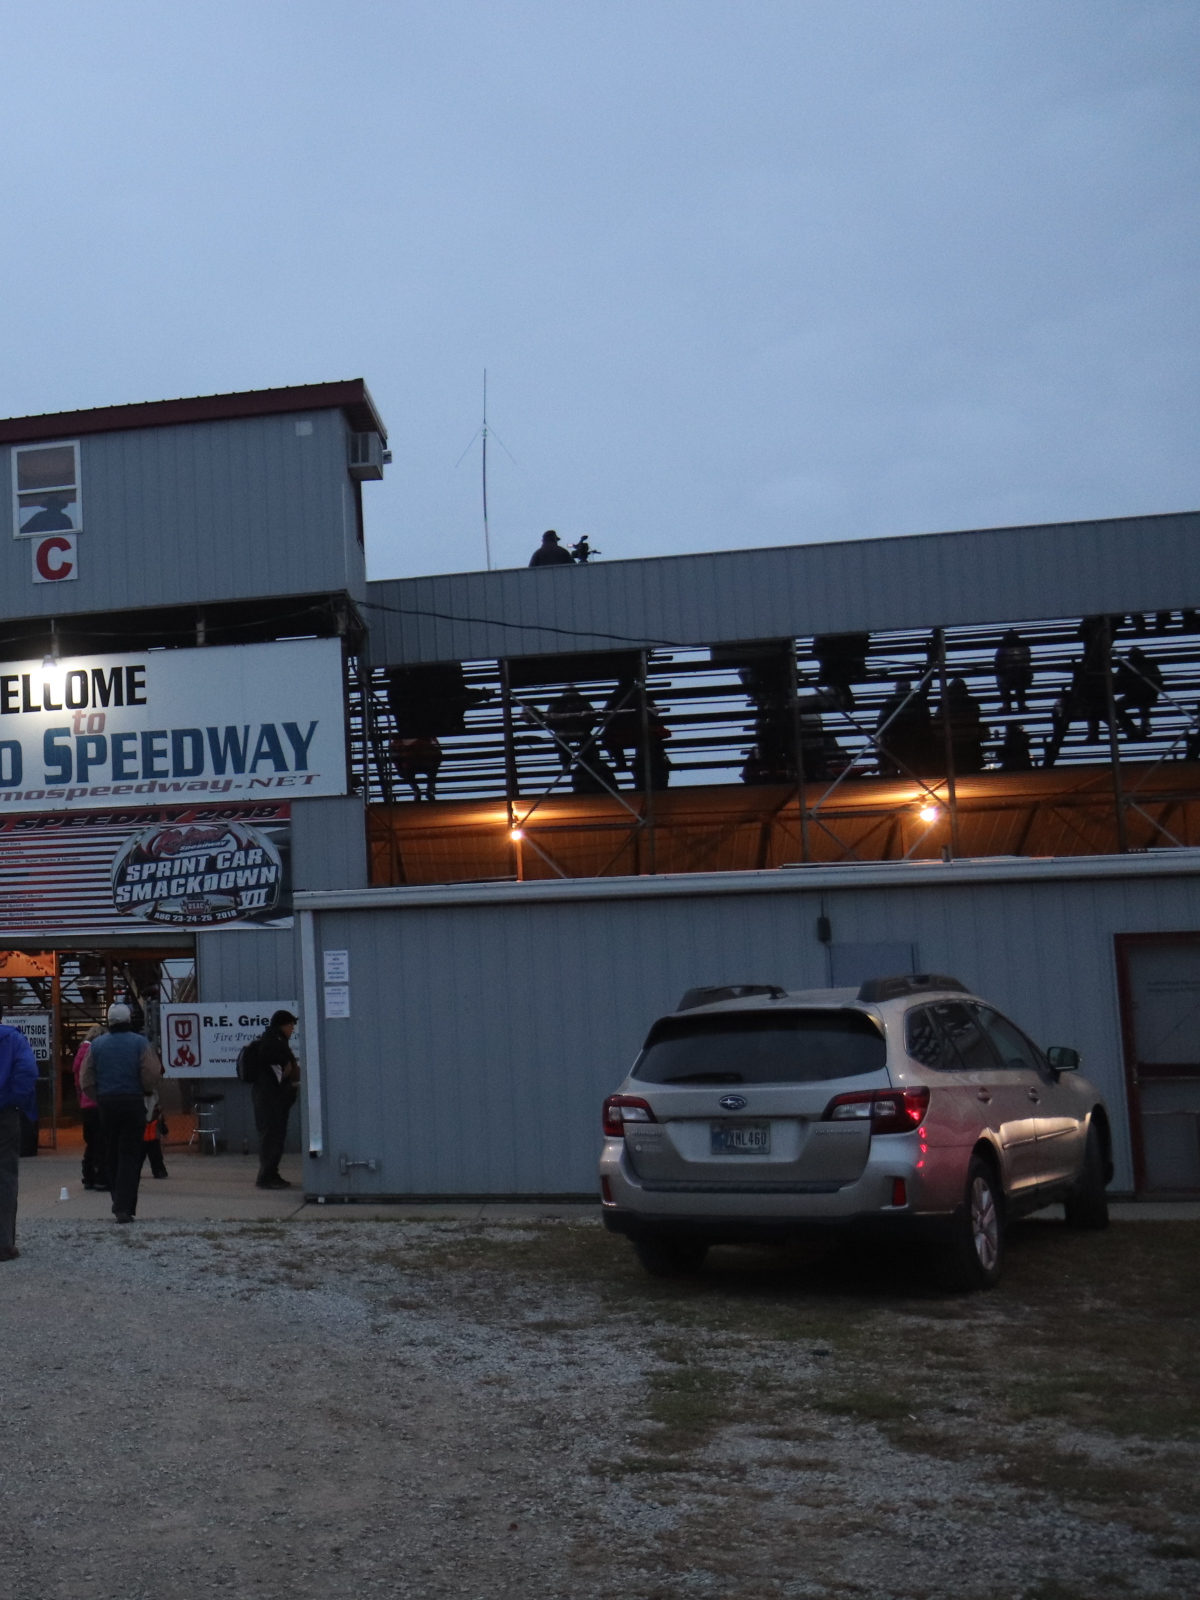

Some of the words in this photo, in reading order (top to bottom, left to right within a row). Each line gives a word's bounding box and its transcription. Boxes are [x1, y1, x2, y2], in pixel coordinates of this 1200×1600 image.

[36, 537, 73, 580] C
[72, 709, 106, 735] to
[43, 720, 318, 785] SPEEDWAY
[11, 808, 192, 831] SPEEDAY
[194, 805, 282, 822] 2018
[179, 840, 228, 851] Speedway
[126, 855, 210, 882] SPRINT
[216, 848, 264, 869] CAR
[115, 865, 278, 904] SMACKDOWN
[240, 888, 269, 908] VII
[154, 911, 171, 920] AUG
[172, 914, 213, 922] 23-24-25
[216, 909, 237, 920] 2018
[203, 1016, 233, 1027] R.E.
[30, 1038, 46, 1047] DRINK
[213, 1032, 234, 1042] Fire
